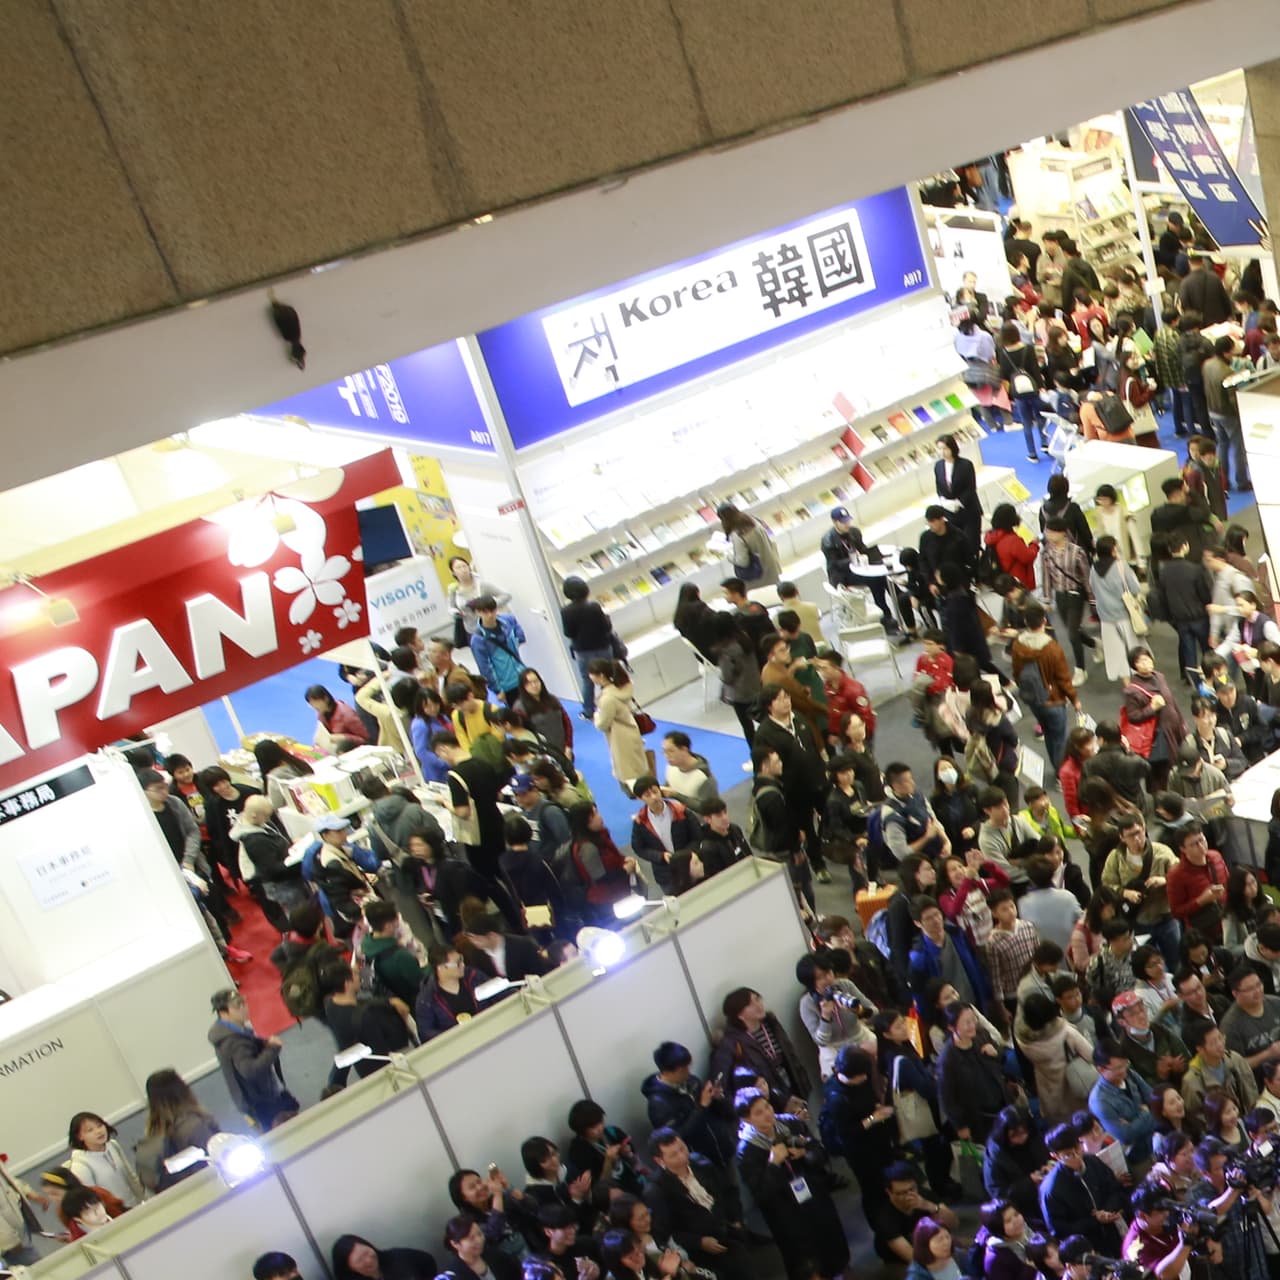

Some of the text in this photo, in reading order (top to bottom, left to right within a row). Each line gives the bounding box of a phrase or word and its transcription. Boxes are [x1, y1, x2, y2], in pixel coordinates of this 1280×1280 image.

[618, 267, 739, 328] Korea
[751, 221, 865, 318] 韓國
[0, 570, 279, 766] PAN
